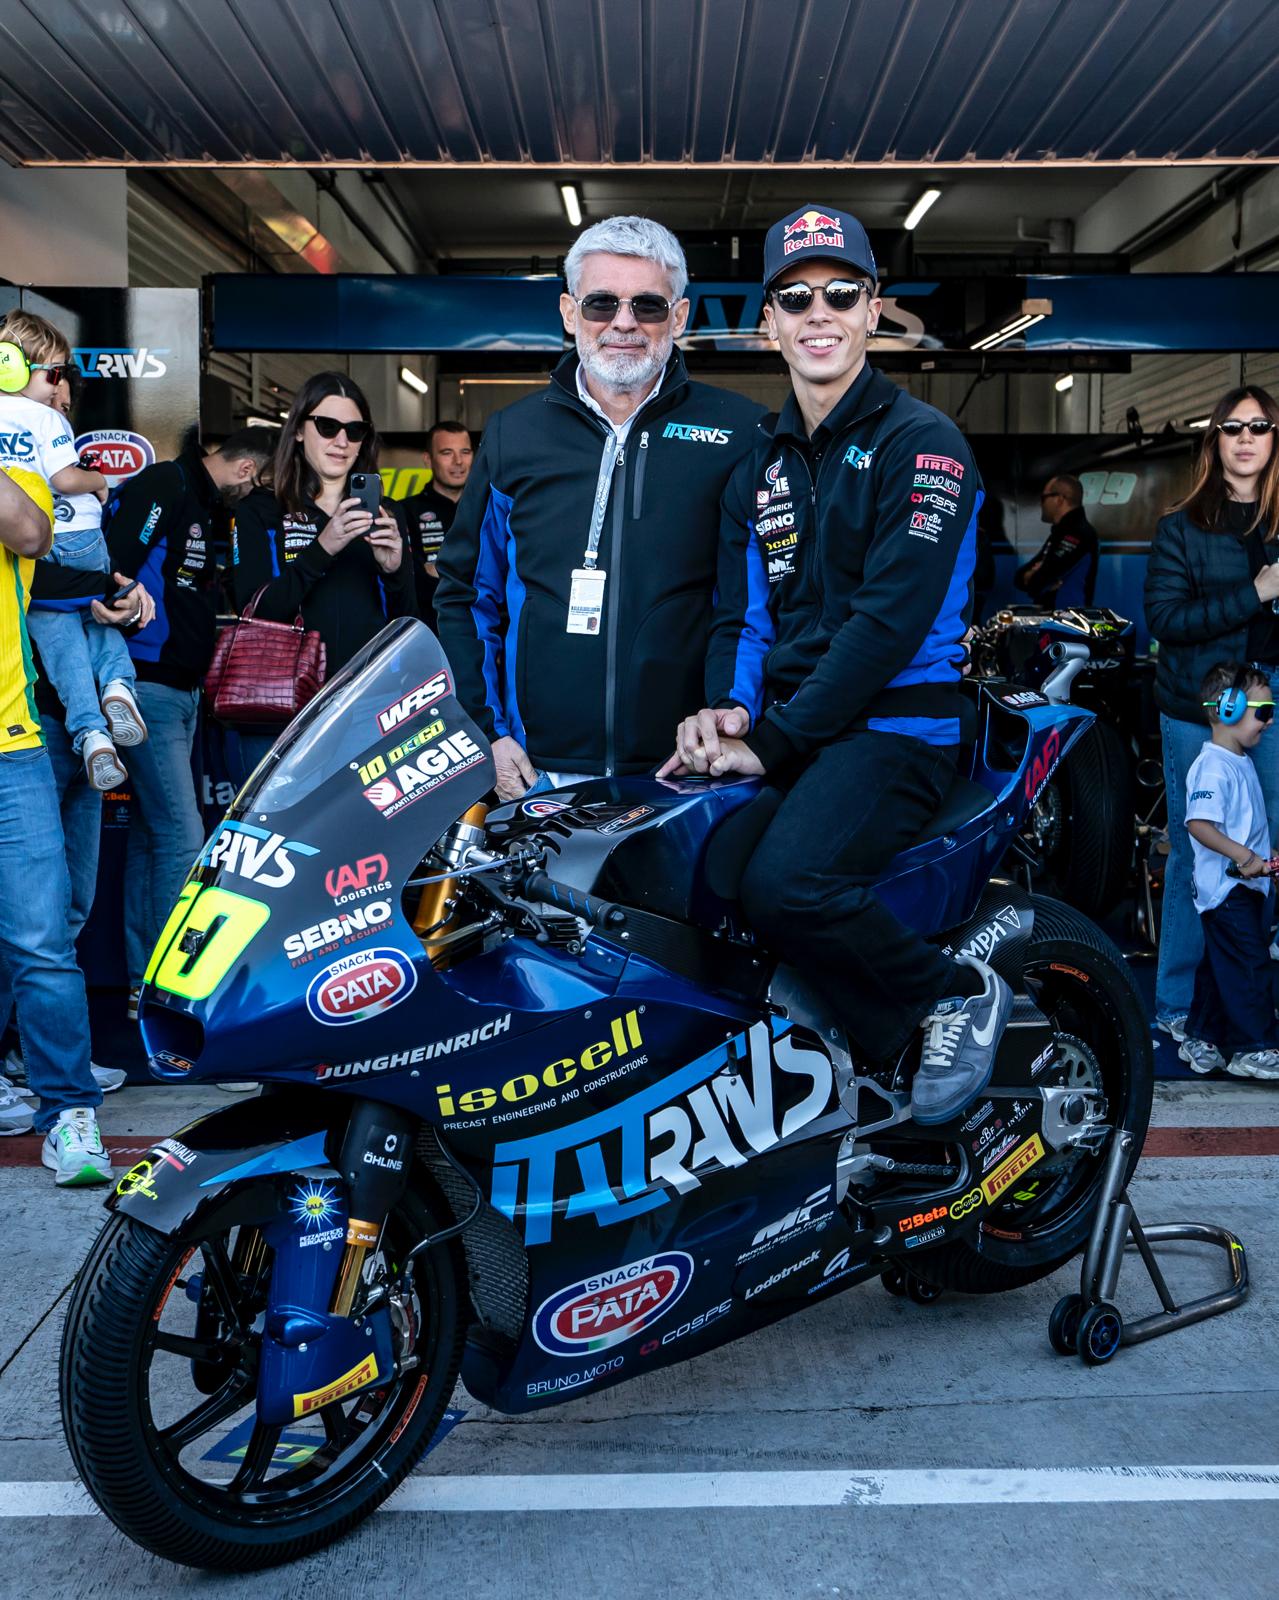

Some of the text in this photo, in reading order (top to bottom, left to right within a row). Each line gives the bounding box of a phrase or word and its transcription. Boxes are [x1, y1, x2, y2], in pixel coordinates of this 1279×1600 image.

[784, 232, 844, 255] Red Bull
[93, 432, 128, 442] SNACK
[913, 474, 944, 485] BRUNO
[916, 454, 964, 480] PIRELLI
[379, 673, 447, 733] WRS
[1014, 691, 1043, 704] AGIE
[357, 755, 387, 786] 10
[396, 730, 481, 795] AGIE
[382, 752, 485, 818] IMPIANTI ELETTRICI E TECNOLOGICI
[1028, 757, 1060, 809] LOGISTICS
[602, 807, 650, 833] KALEX
[334, 881, 393, 906] LOGISTICS
[142, 881, 271, 1001] 10
[291, 920, 394, 969] FIRE AND SECURITY
[942, 944, 954, 956] BY
[330, 952, 374, 976] SNACK
[327, 970, 395, 1010] PATA
[936, 1002, 953, 1012] NIKE
[316, 1013, 512, 1080] JUNGHEINRICH
[436, 1005, 646, 1117] isocell
[443, 1054, 649, 1131] PRECAST ENGINEERING AND CONSTRUCTIONS
[1007, 1102, 1033, 1128] INVIDIA
[363, 1151, 404, 1170] ÖHLINS
[987, 1141, 1039, 1196] PIRELLI
[912, 1206, 948, 1228] Beta
[587, 1260, 651, 1292] SNACK
[745, 1248, 822, 1300] Lodotruck
[572, 1279, 661, 1334] PATA
[662, 1298, 733, 1345] COSPE
[302, 1363, 372, 1413] PIRELLI
[527, 1355, 625, 1395] BRUNO MOTO
